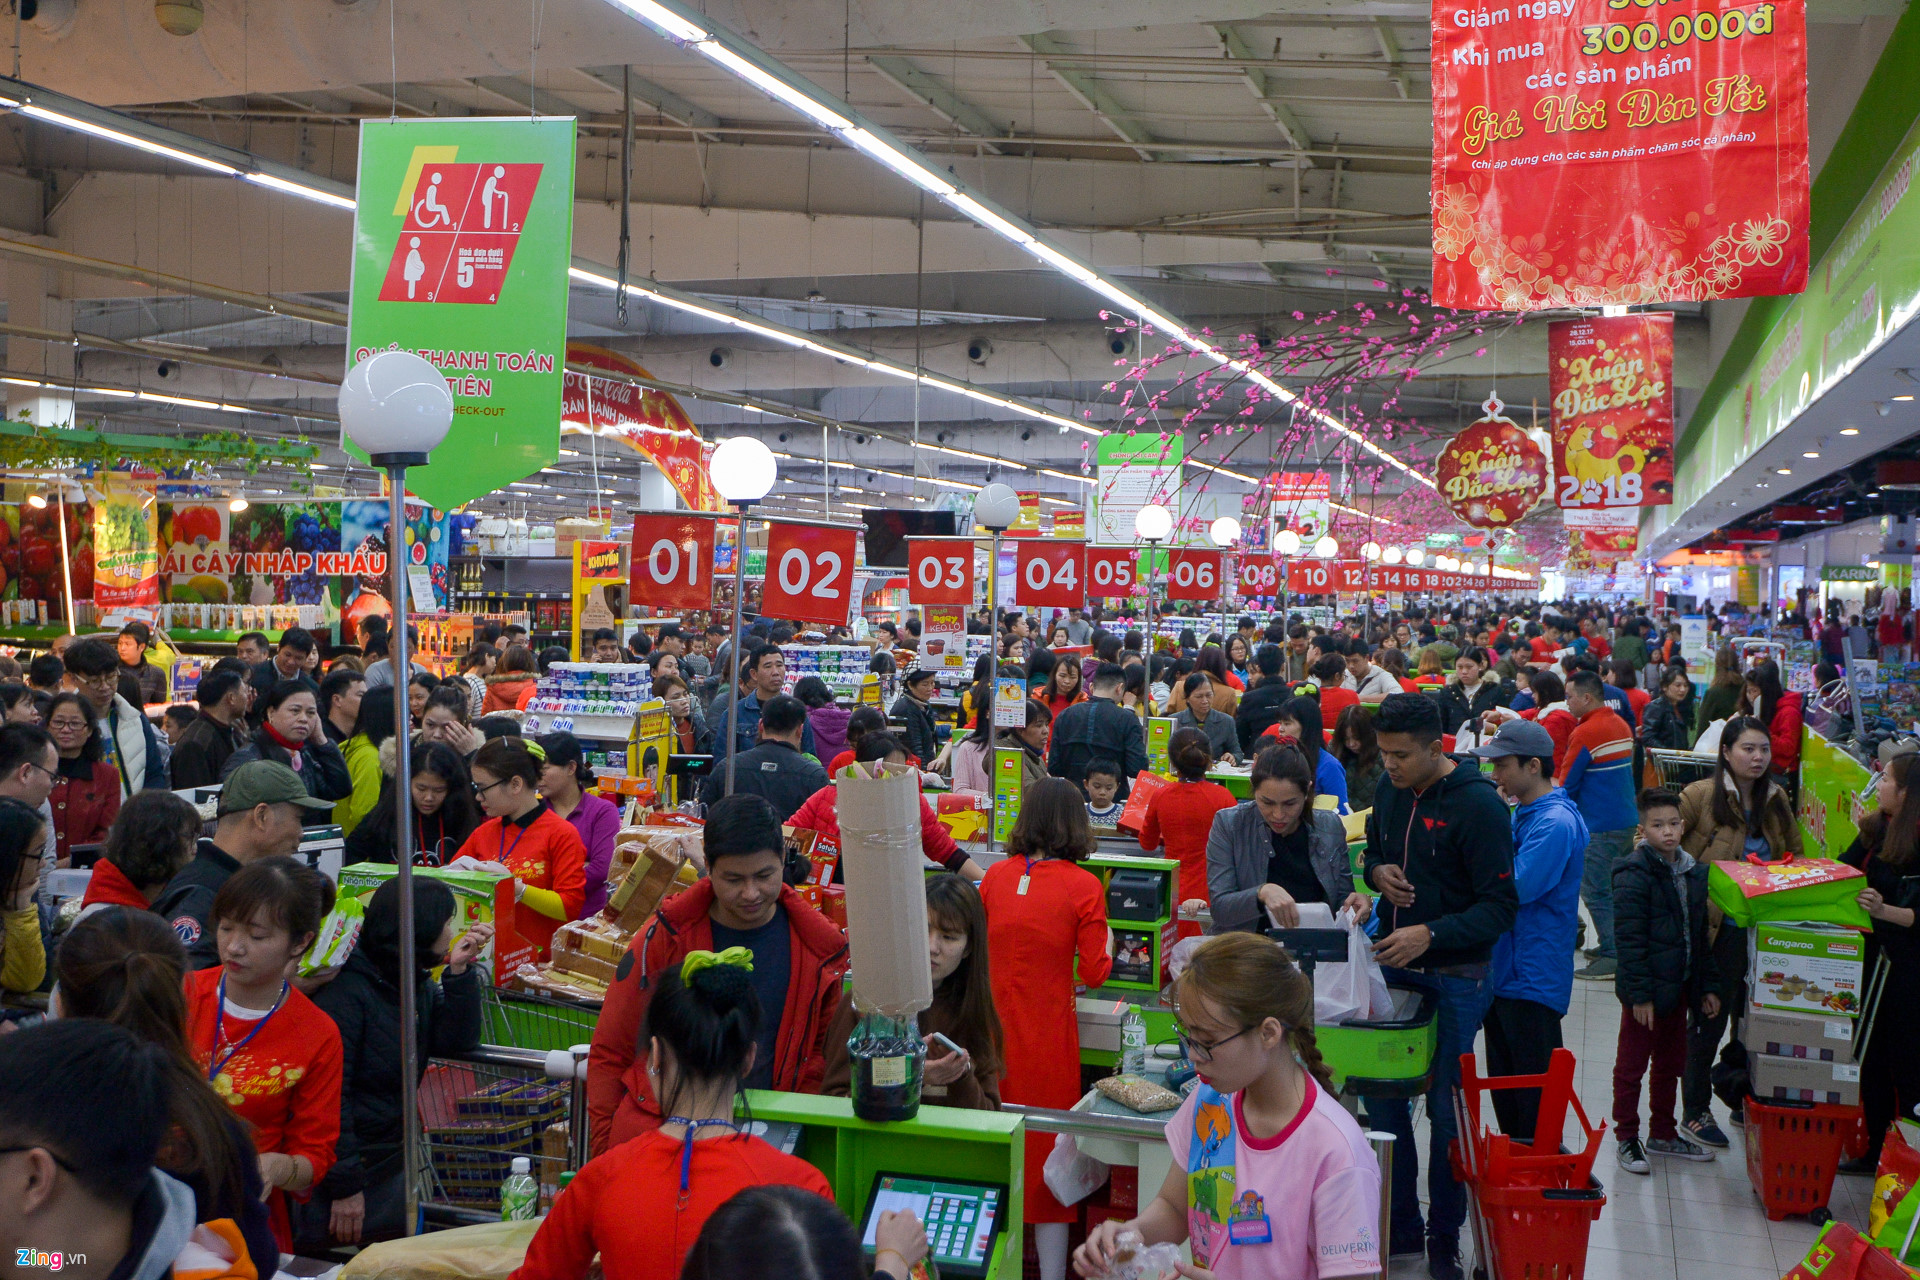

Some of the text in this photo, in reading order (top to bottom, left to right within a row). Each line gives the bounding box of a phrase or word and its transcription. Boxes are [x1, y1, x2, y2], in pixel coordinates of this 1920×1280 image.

[1454, 7, 1510, 27] Giảm
[1582, 4, 1776, 56] 300.000đ
[1453, 41, 1544, 66] Khi mua
[1526, 54, 1691, 89] các sản phẩm
[1462, 74, 1767, 156] Giá Hời Đón Tết
[1510, 154, 1539, 168] dụng
[1542, 151, 1564, 162] cho
[1566, 149, 1587, 160] các
[1611, 144, 1645, 160] phẩm
[1681, 136, 1701, 149] sóc
[452, 223, 458, 231] 1
[512, 223, 519, 231] 2
[457, 256, 474, 288] 5
[427, 292, 434, 300] 3
[489, 293, 496, 302] 4
[418, 350, 489, 370] THANH
[495, 350, 555, 373] TOÁN
[452, 405, 506, 417] HECK-OUT
[562, 396, 585, 415] RÀN
[192, 548, 242, 575] CÂY
[245, 547, 313, 580] NHẬP
[316, 543, 387, 576] KHẨU
[588, 549, 619, 569] KHUYẾN
[648, 538, 699, 586] 01
[778, 547, 842, 599] 02
[918, 556, 965, 589] 03
[1025, 557, 1078, 591] 04
[1094, 560, 1131, 586] 05
[1175, 561, 1214, 588] 06
[1243, 564, 1276, 586] 08
[1304, 568, 1328, 586] 10
[1343, 569, 1362, 585] 12
[1371, 573, 1379, 586] 5
[1383, 571, 1401, 586] 14
[1404, 573, 1420, 587] 16
[1425, 574, 1439, 587] 18
[1828, 568, 1879, 580] KARINA
[1764, 936, 1814, 949] Kangaroo
[1321, 1240, 1377, 1256] DELIVERIN
